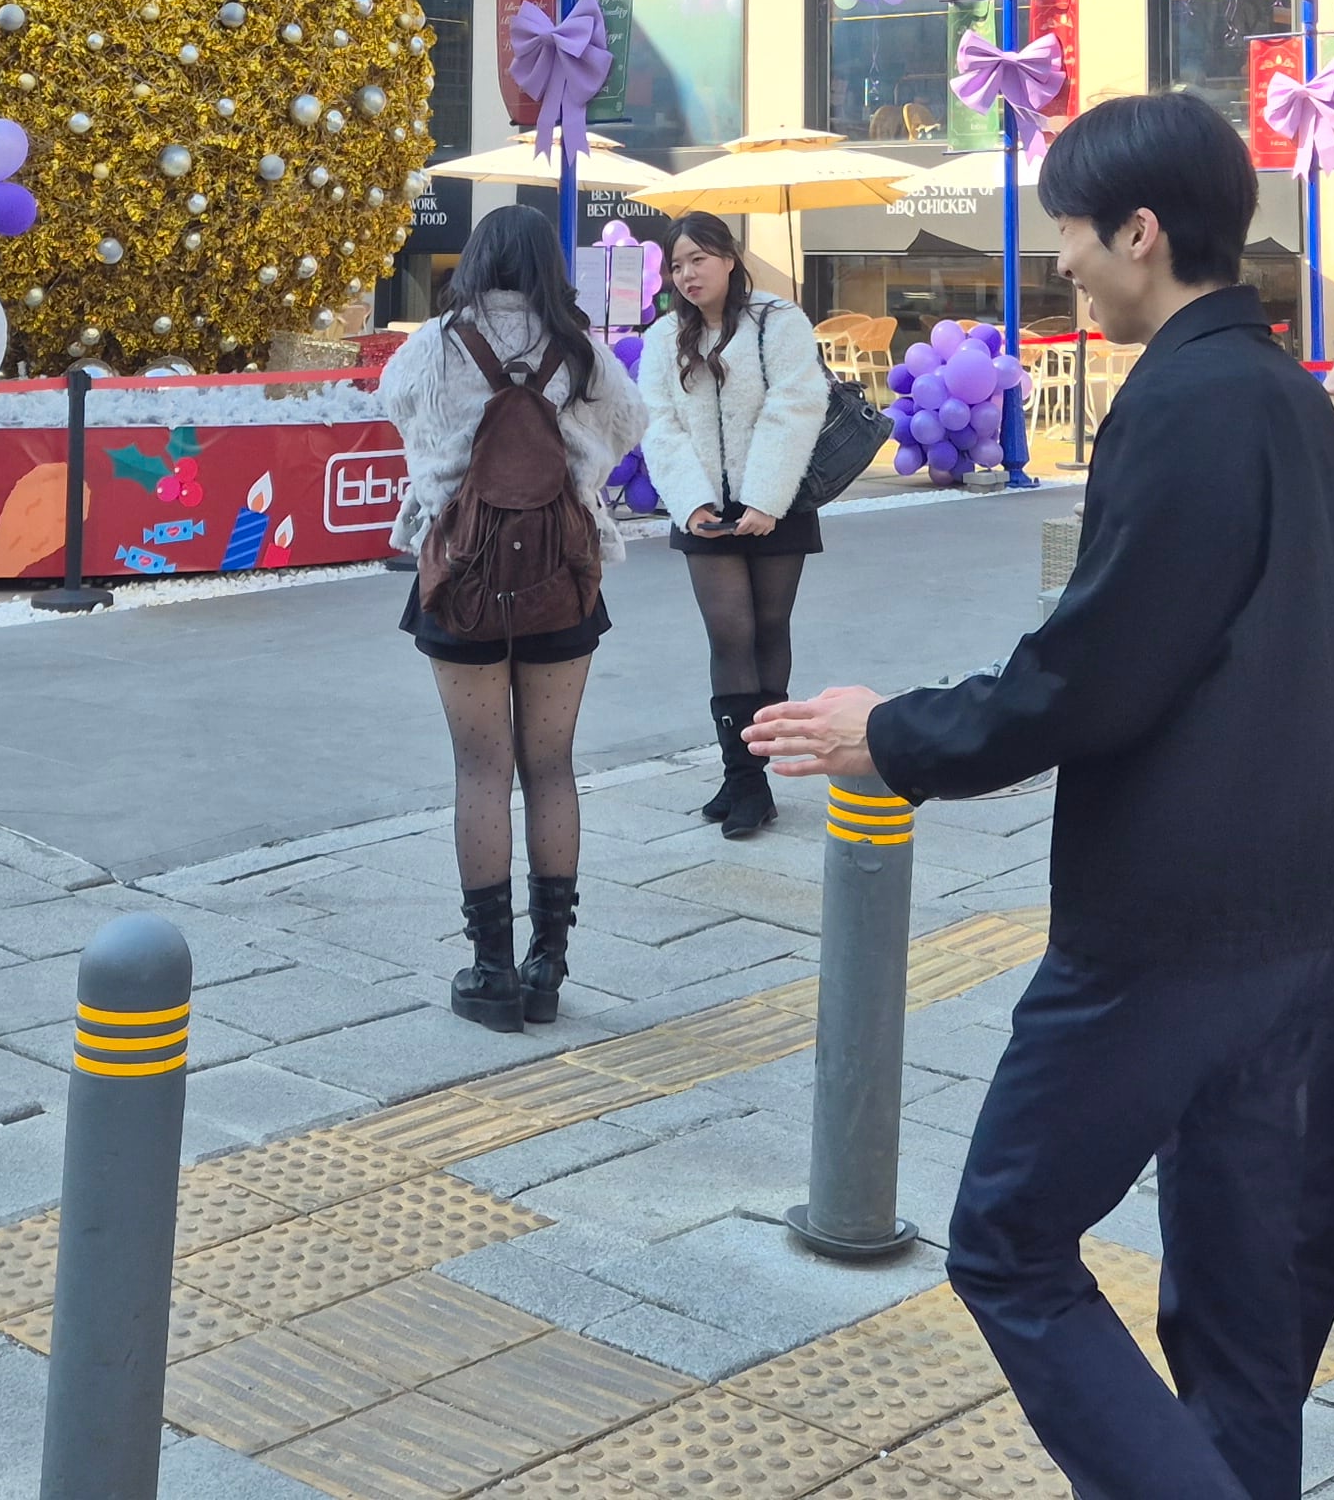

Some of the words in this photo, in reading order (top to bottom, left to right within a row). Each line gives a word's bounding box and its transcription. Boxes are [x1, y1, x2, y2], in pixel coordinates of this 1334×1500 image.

[587, 203, 614, 217] BEST
[886, 199, 916, 218] BBQ
[917, 198, 978, 215] CHICKEN
[420, 212, 447, 226] FOOD
